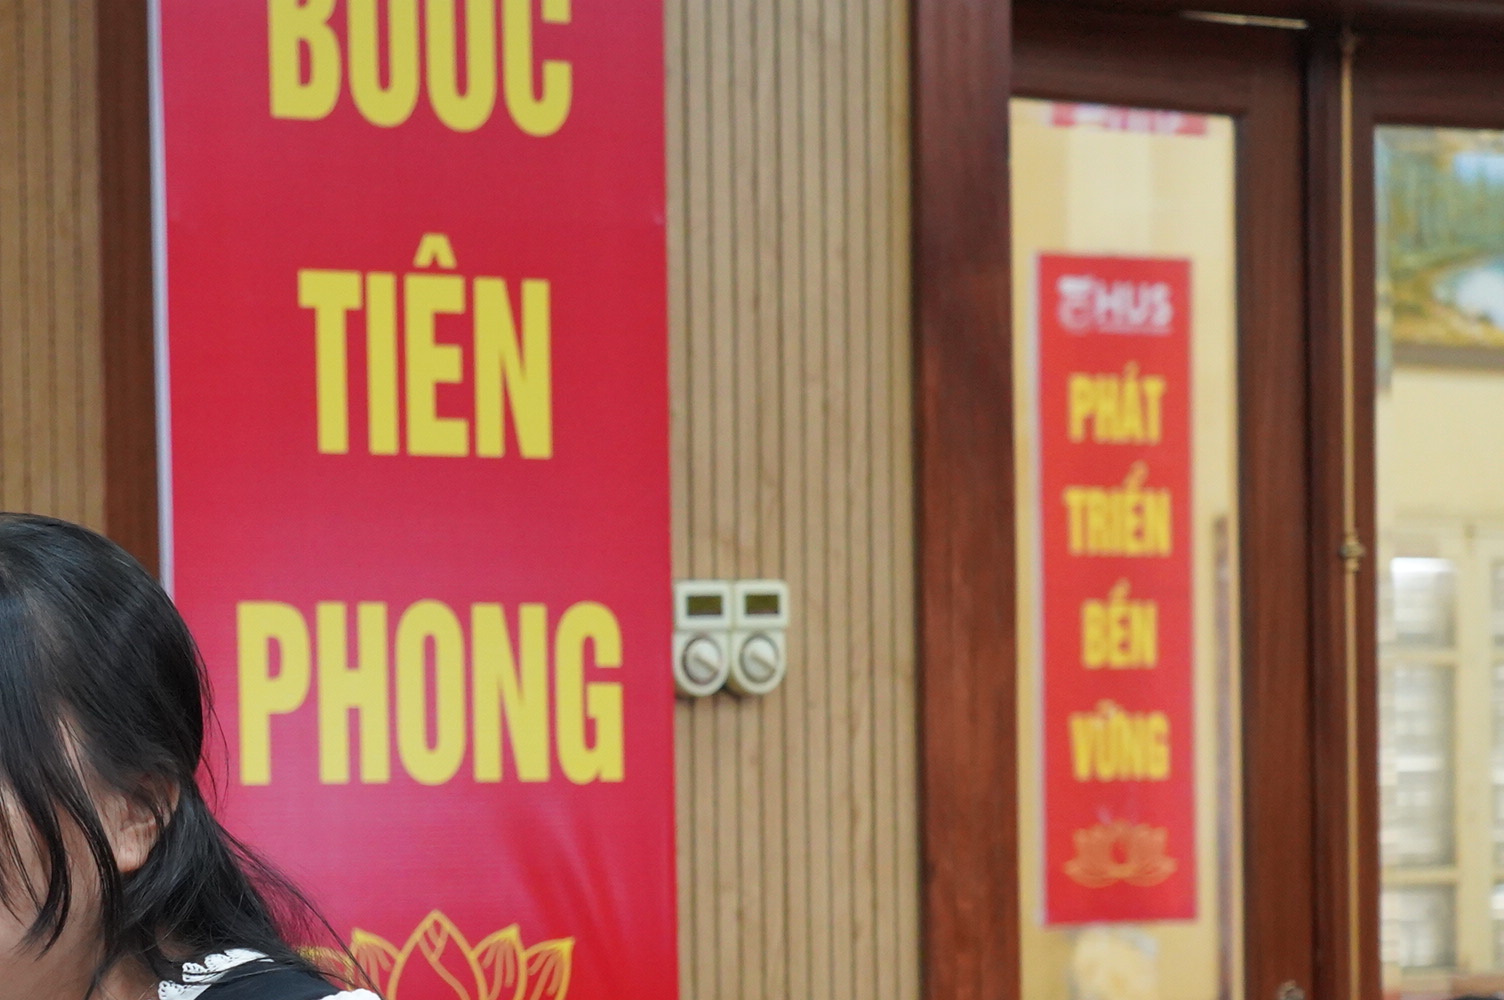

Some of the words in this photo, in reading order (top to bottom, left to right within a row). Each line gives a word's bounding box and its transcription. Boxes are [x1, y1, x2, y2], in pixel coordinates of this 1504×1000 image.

[297, 233, 552, 459] TIÊN
[1068, 362, 1165, 444] PHÁT
[236, 599, 624, 785] PHONG
